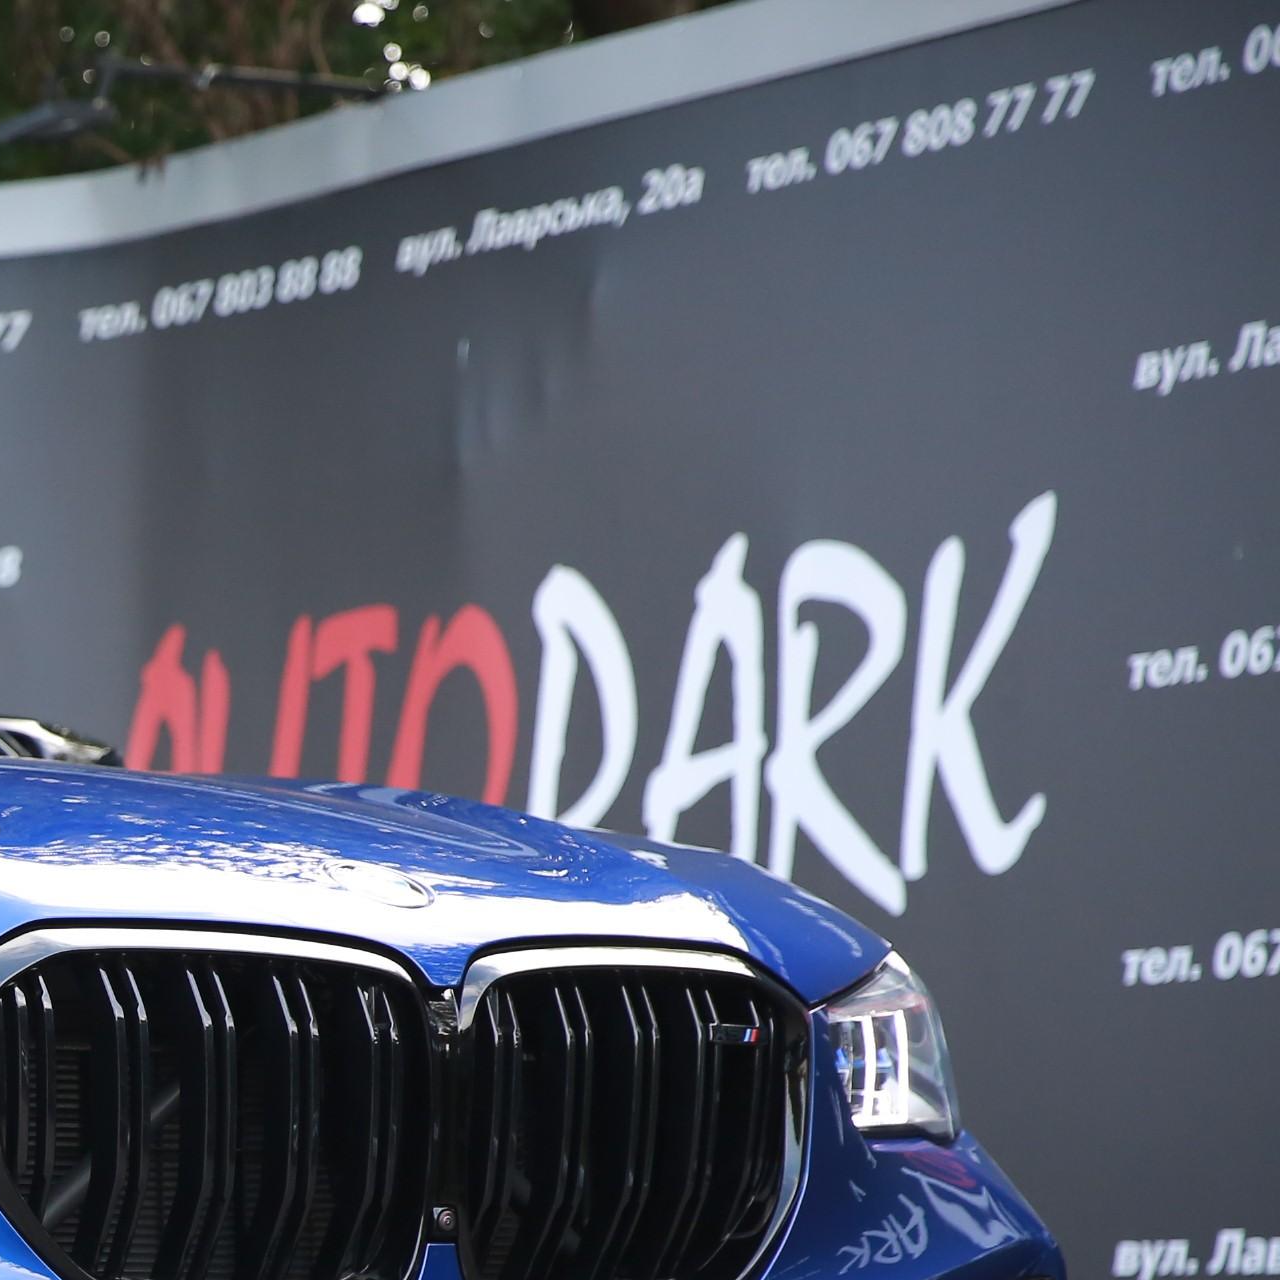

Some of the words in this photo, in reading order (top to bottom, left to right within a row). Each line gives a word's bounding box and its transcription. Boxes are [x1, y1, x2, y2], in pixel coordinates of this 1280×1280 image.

[1150, 45, 1231, 97] тел.
[746, 147, 817, 194] тел.
[824, 116, 899, 175] 067
[901, 97, 977, 157] 808
[983, 82, 1037, 138] 77
[1041, 68, 1096, 125] 77
[395, 226, 463, 277] вул.
[466, 186, 632, 255] Лаврська,
[78, 301, 147, 342] тел.
[151, 277, 214, 329] 067
[213, 265, 275, 317] 803
[275, 256, 318, 303] 88
[318, 245, 363, 294] 88
[1132, 340, 1220, 397] вул.
[125, 603, 519, 807] AUTO
[526, 489, 1058, 917] PARK
[1127, 645, 1208, 692] тел.
[1121, 945, 1202, 987] тел.
